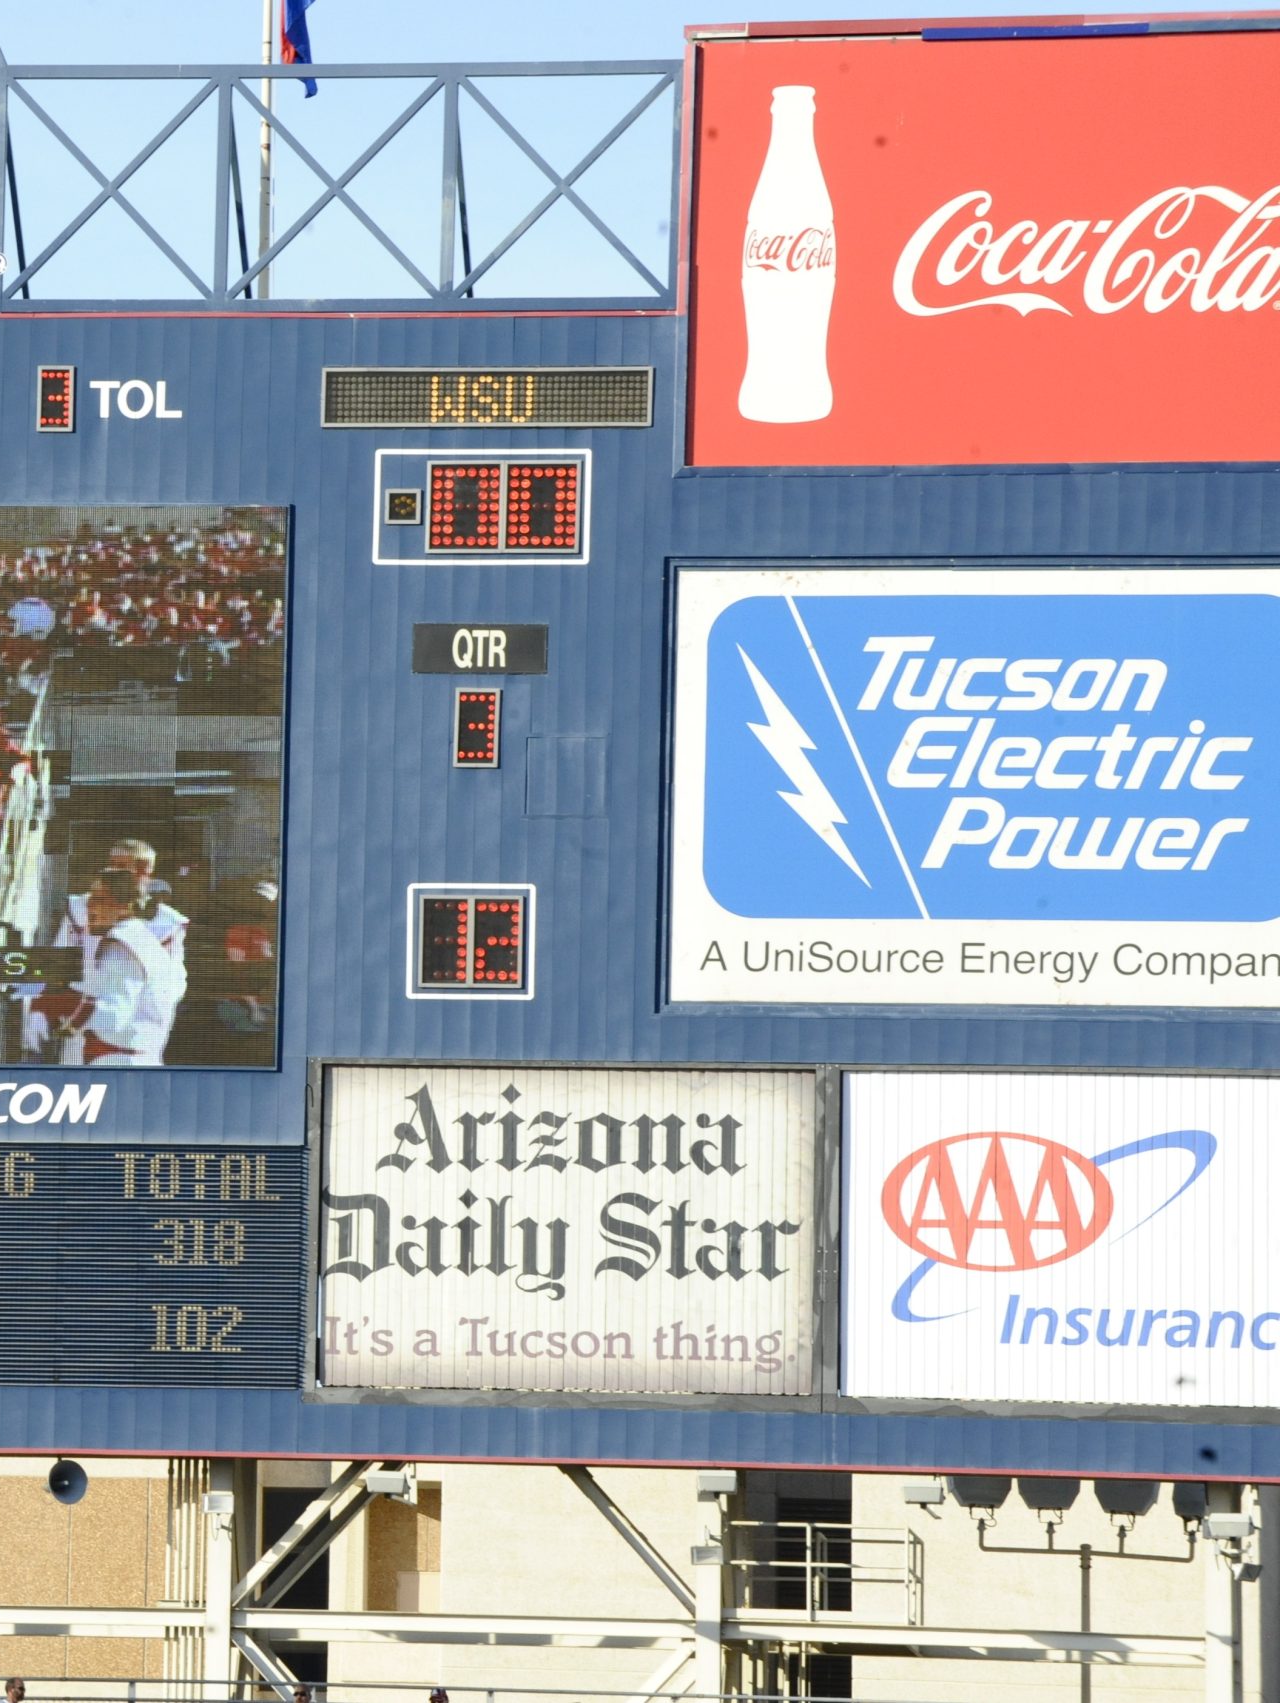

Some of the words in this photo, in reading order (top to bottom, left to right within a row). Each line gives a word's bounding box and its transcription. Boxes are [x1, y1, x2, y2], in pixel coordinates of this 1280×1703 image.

[745, 227, 833, 273] Coca-Cola
[893, 186, 1280, 317] Coca-Cola
[41, 370, 71, 425] 3
[90, 380, 183, 419] TOL
[429, 374, 534, 423] WSU
[452, 629, 506, 668] QTR
[857, 635, 1168, 711] Tucson
[460, 694, 497, 758] 3
[887, 717, 1254, 790] Electric
[920, 797, 1250, 871] Power
[699, 940, 728, 972] A
[743, 941, 945, 974] UniSource
[960, 942, 1099, 984] Energy
[1112, 943, 1280, 985] Compan
[376, 1082, 748, 1177] Arizona
[115, 1152, 281, 1200] TOTAL
[900, 1134, 1096, 1270] AAA
[153, 1218, 245, 1266] 318
[322, 1185, 571, 1301] Daily
[594, 1191, 805, 1282] Star
[150, 1304, 243, 1351] 102
[324, 1316, 395, 1357] It's
[413, 1329, 441, 1357] a
[458, 1316, 636, 1360] Tucson
[652, 1319, 796, 1374] thing.
[999, 1294, 1280, 1351] Insuranc
